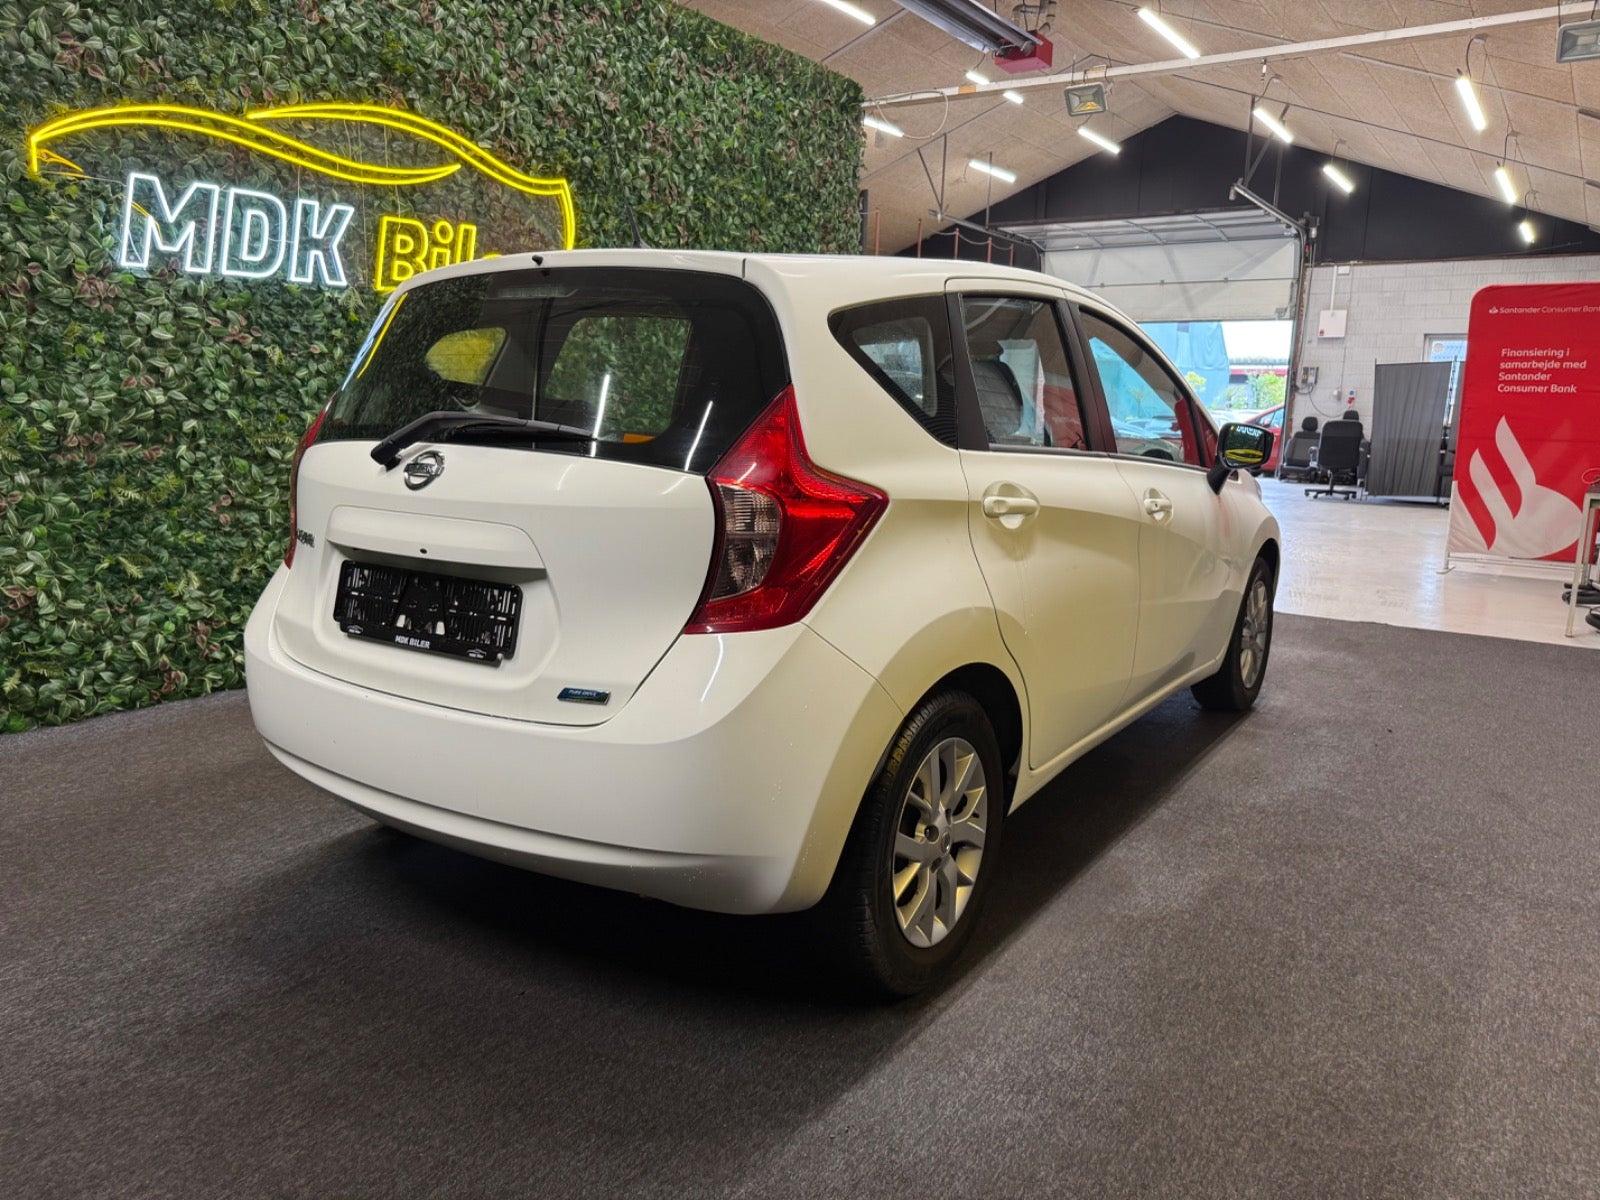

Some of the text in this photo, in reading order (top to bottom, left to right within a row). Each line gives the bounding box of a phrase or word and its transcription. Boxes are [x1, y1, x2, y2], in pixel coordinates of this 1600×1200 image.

[118, 171, 501, 292] MDK Bil
[1499, 306, 1541, 314] Santander
[1541, 305, 1582, 313] Consumer
[1501, 348, 1570, 359] Finansiering i
[1500, 360, 1587, 371] samarbejde med
[1498, 371, 1552, 381] Santander
[1497, 383, 1577, 393] Consumer Bank
[409, 637, 431, 649] BILER
